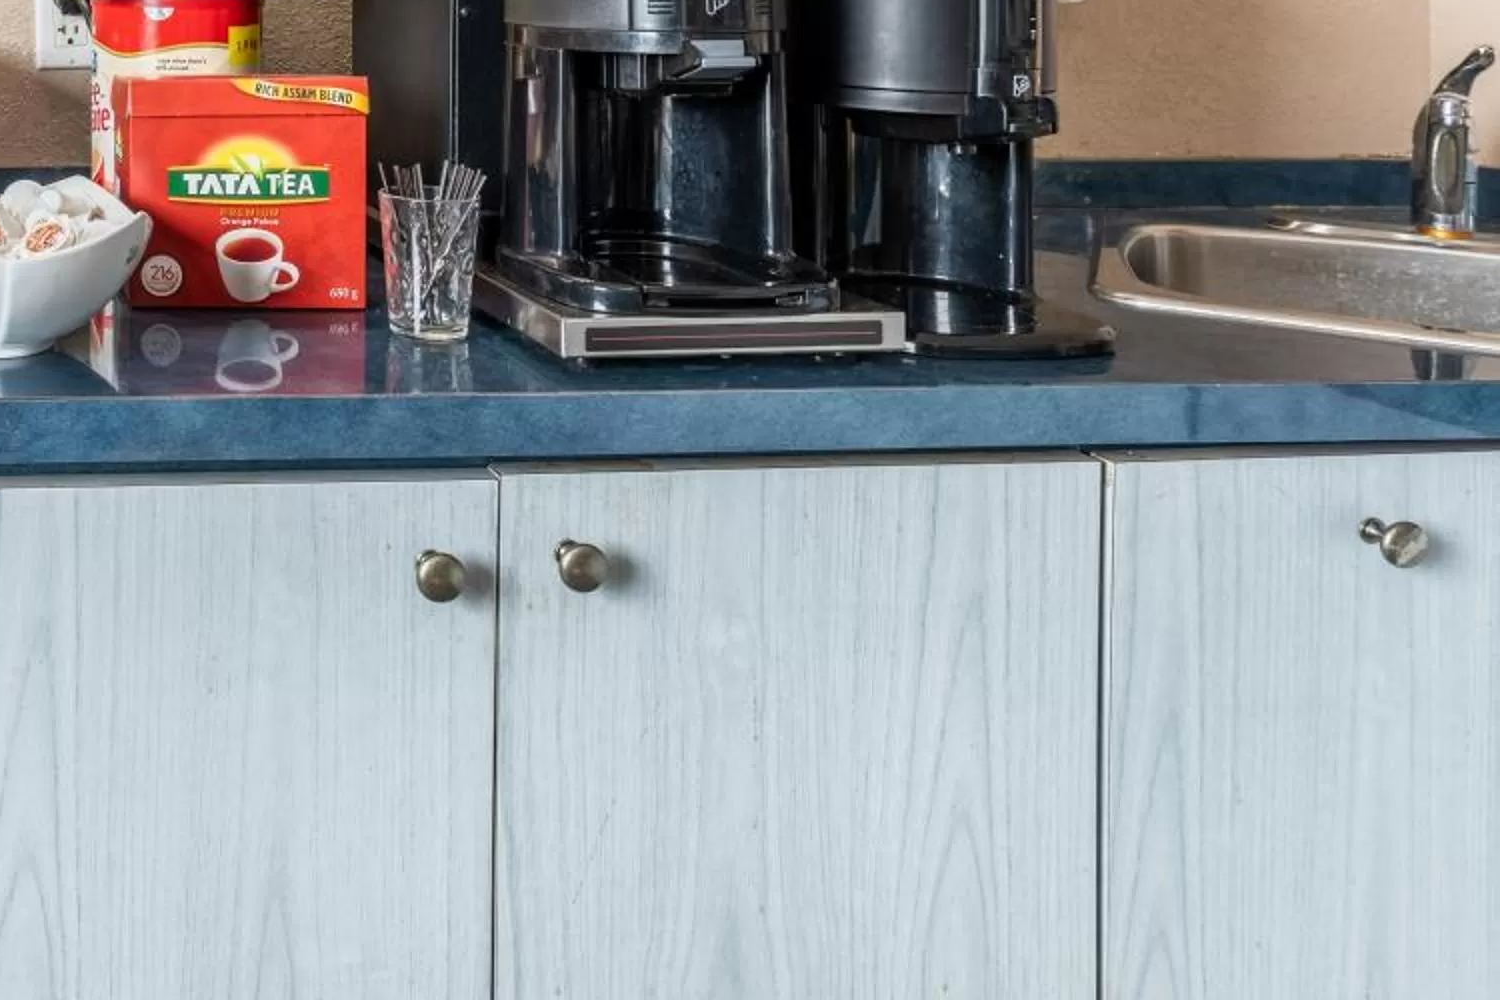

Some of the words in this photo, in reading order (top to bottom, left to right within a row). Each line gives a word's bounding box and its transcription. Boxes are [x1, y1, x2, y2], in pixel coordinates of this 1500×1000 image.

[254, 82, 280, 98] RICH
[282, 86, 318, 100] ASSAM
[319, 88, 353, 105] BLEND
[183, 172, 260, 195] TATA
[265, 171, 315, 195] TEA
[150, 264, 175, 281] 216
